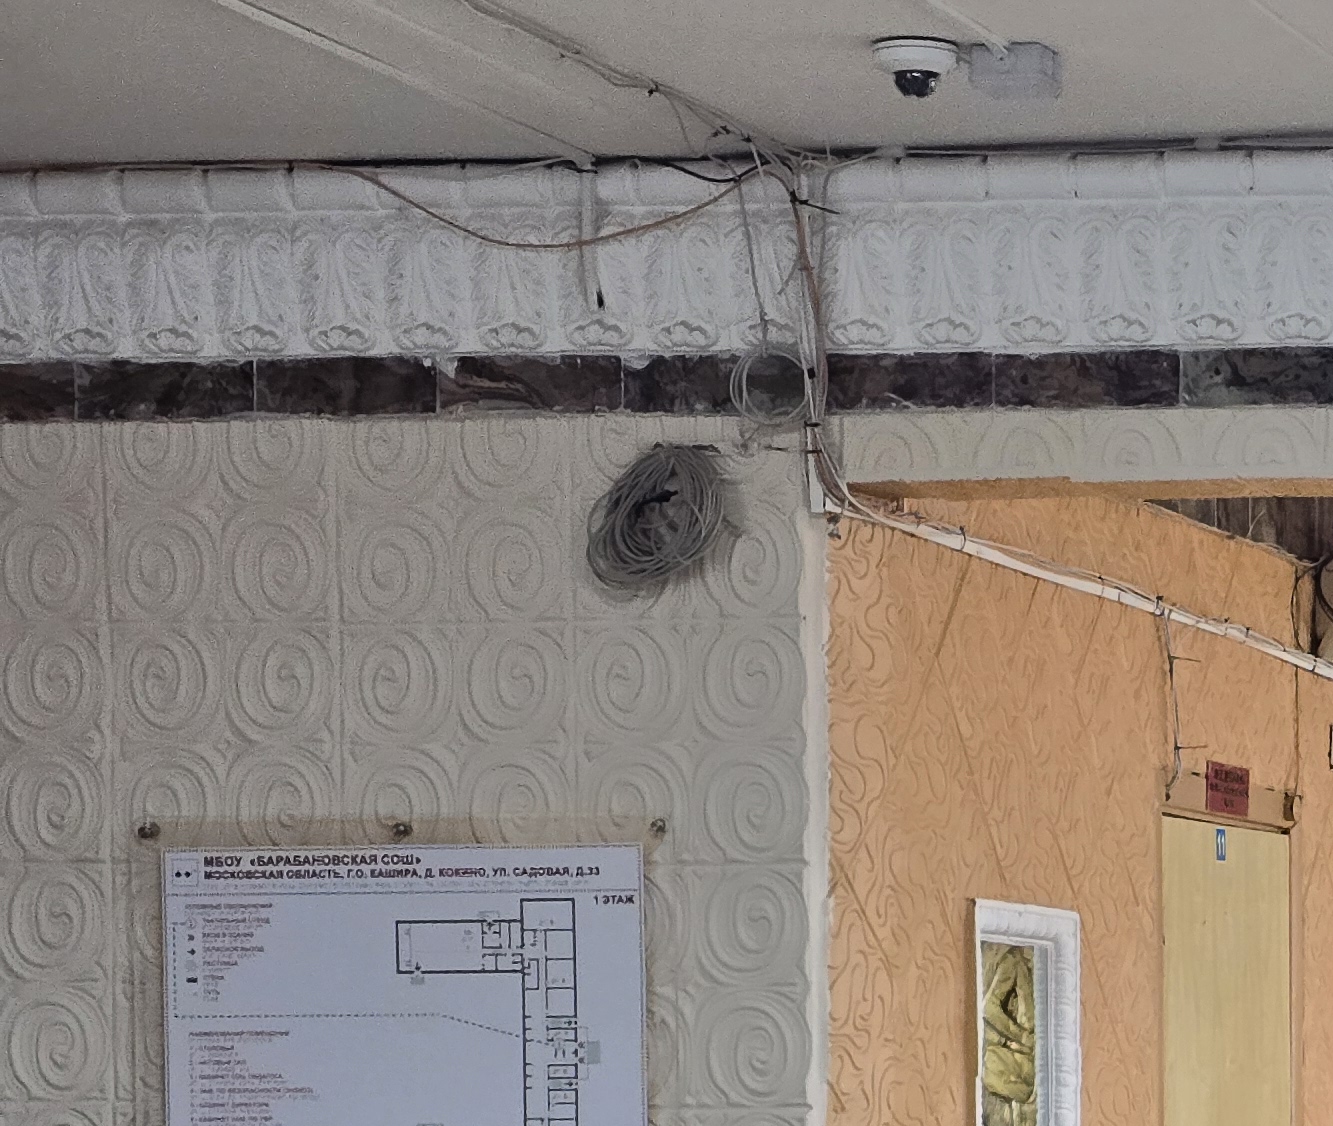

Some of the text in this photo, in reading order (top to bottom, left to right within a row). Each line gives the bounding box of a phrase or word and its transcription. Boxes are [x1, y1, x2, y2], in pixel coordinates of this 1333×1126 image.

[203, 854, 421, 867] МБОУ «БАРАБАНОВСКАЯ СОШ»
[593, 895, 635, 905] 1 ЭТАЖ
